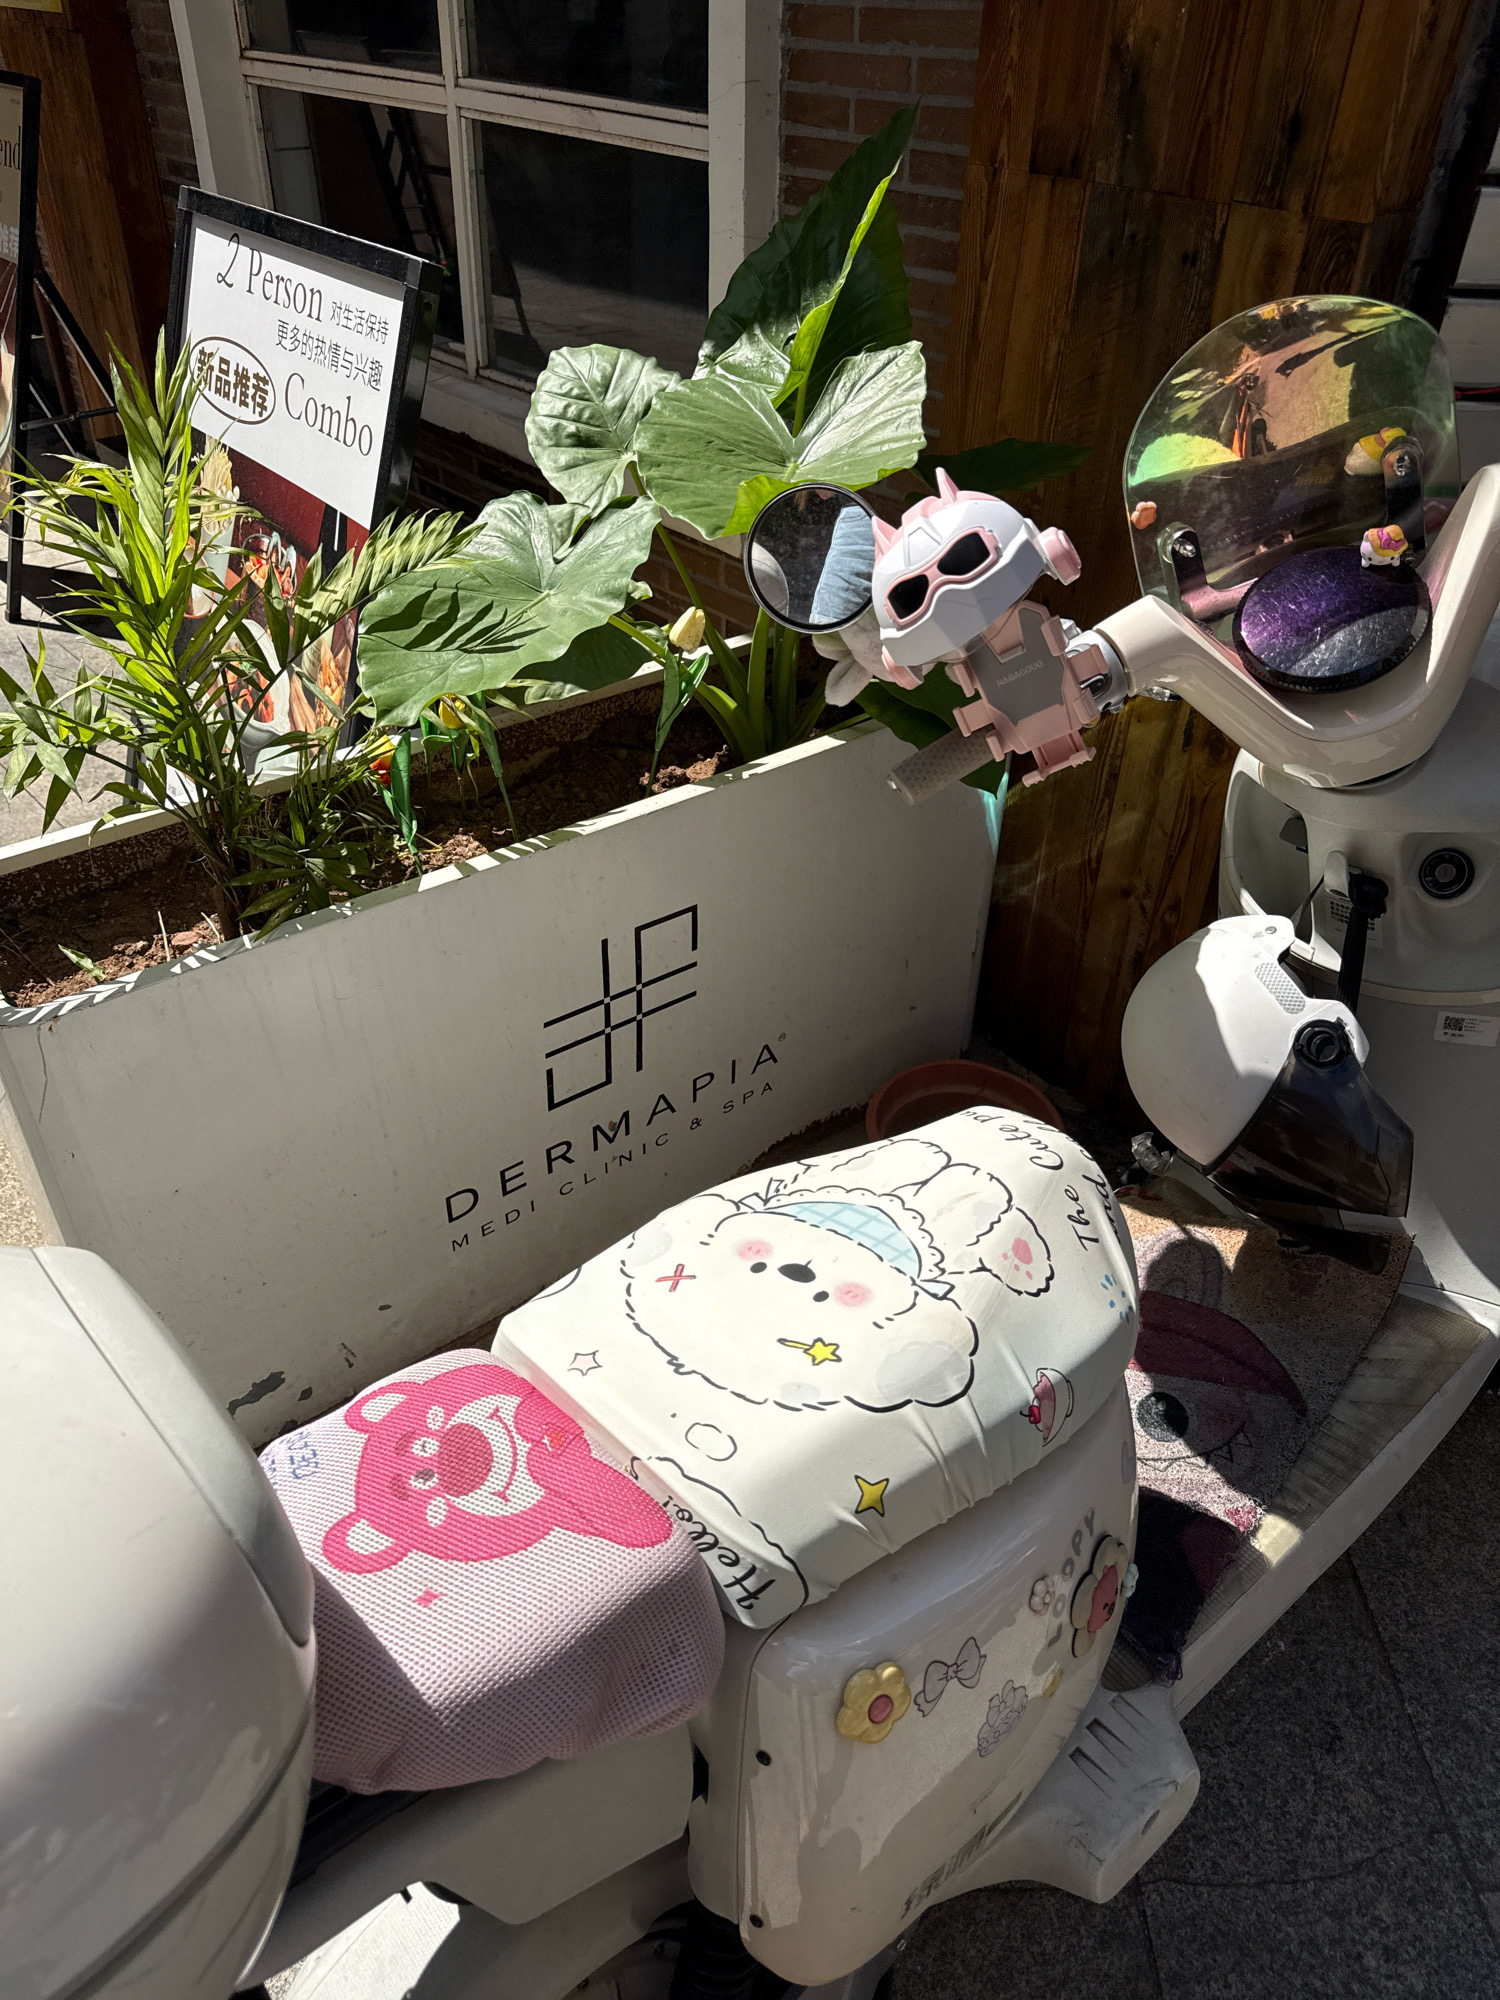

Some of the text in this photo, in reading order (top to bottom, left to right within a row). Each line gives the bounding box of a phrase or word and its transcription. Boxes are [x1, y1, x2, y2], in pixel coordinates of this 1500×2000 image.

[216, 232, 323, 323] 2 Person
[275, 318, 384, 392] 更多的热情与兴趣
[330, 301, 390, 345] 对生活保持
[196, 346, 270, 418] 新品推荐
[285, 372, 373, 457] Combo
[445, 1043, 779, 1223] DERMAPIA
[451, 1082, 773, 1252] MEDI CLINIC & SPA
[999, 1124, 1064, 1170] Cute
[1064, 1184, 1100, 1251] The
[1048, 1507, 1096, 1648] LOOPY
